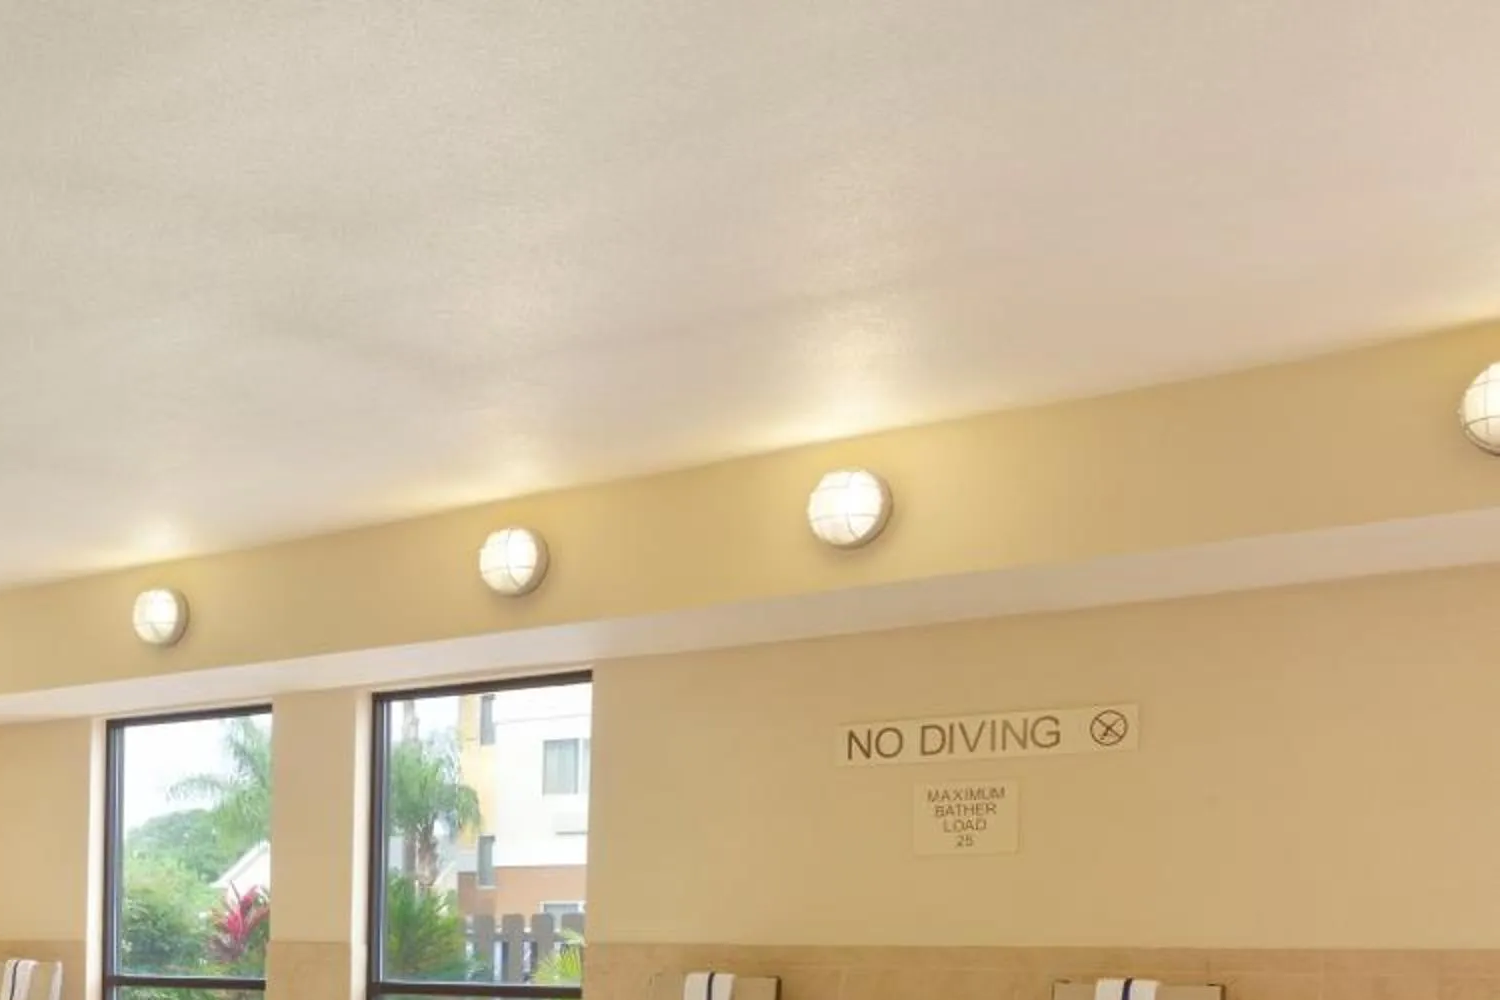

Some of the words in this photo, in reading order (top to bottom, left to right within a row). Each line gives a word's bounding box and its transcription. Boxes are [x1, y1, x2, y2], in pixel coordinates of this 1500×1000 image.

[848, 728, 903, 760] NO
[920, 716, 1061, 756] DIVING
[927, 786, 1005, 802] MAXIMUM
[935, 803, 997, 818] BATHER
[943, 818, 987, 833] LOAD
[955, 834, 974, 848] 25
